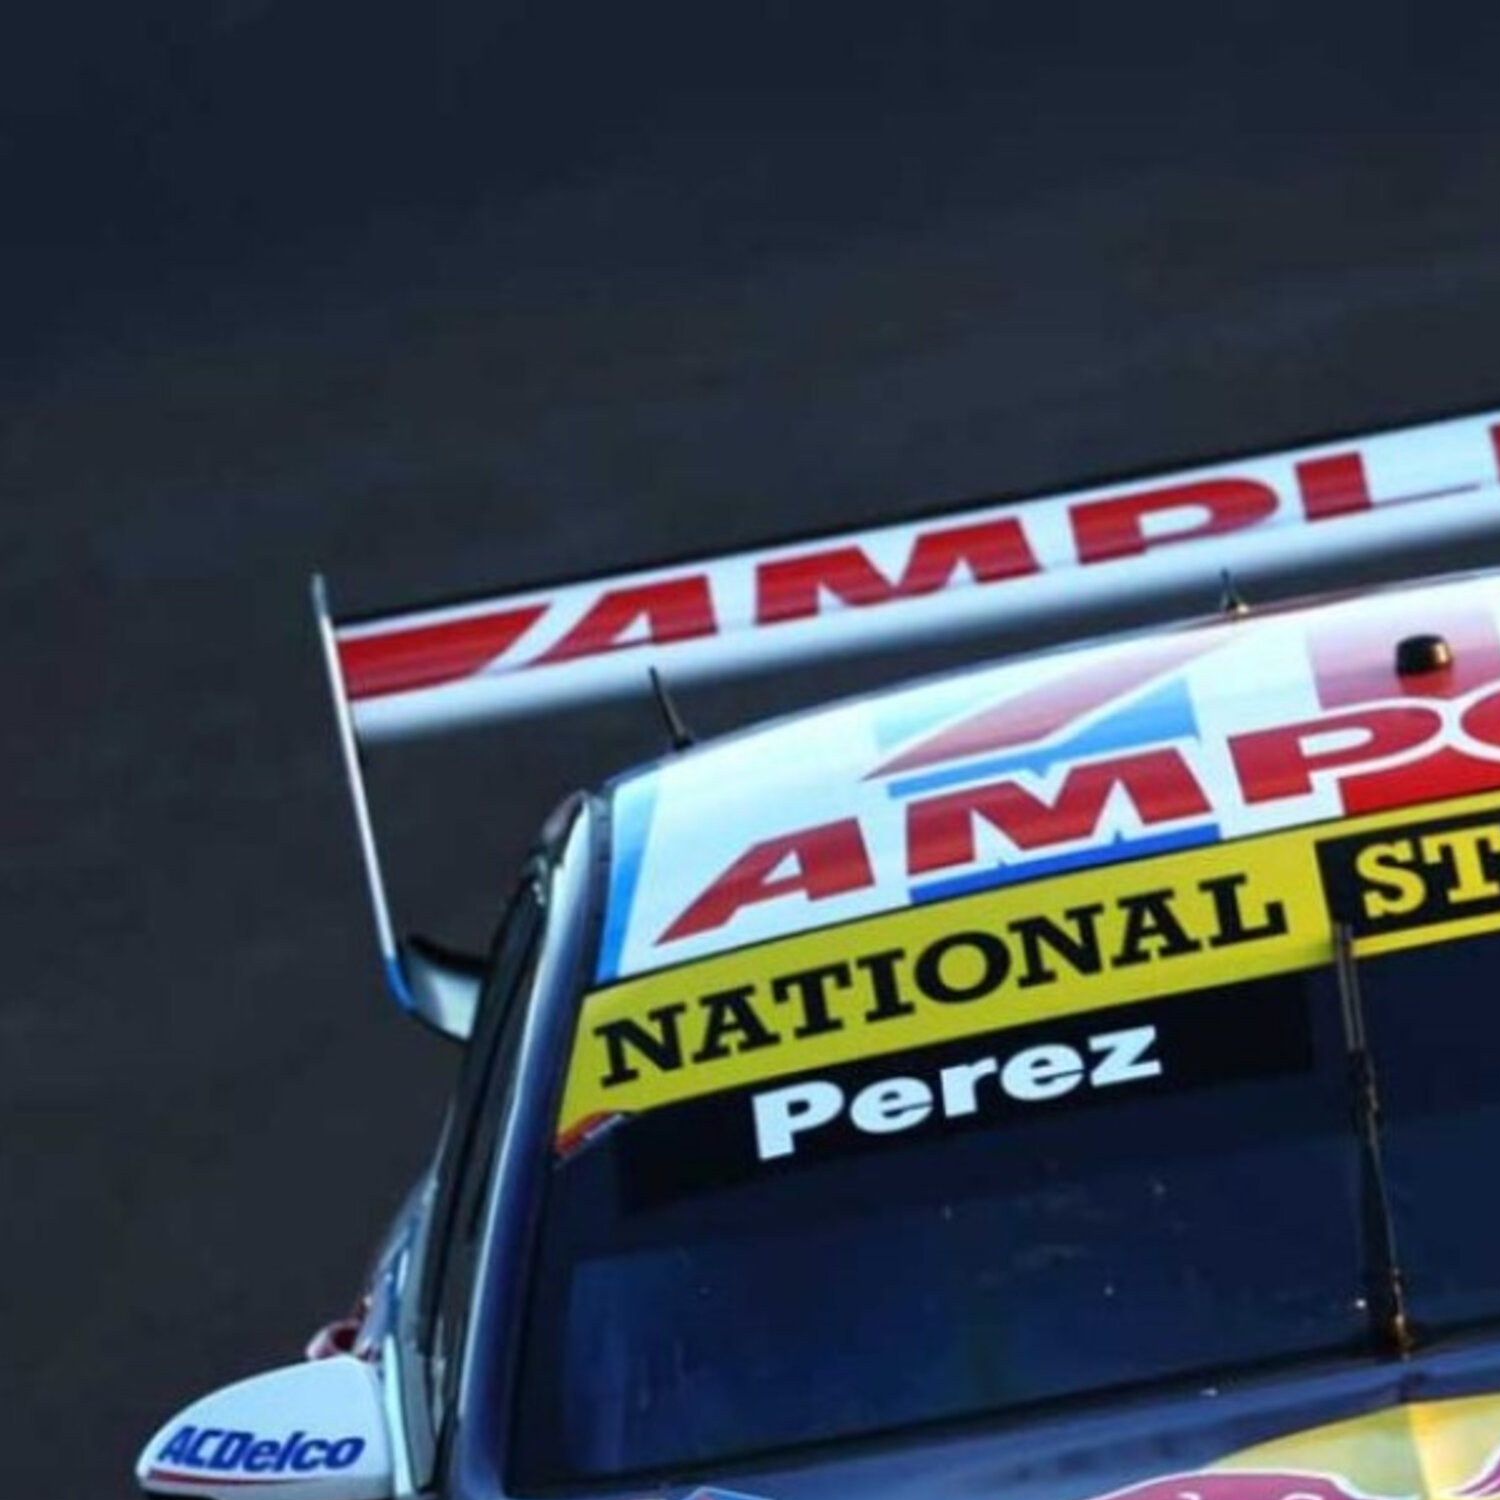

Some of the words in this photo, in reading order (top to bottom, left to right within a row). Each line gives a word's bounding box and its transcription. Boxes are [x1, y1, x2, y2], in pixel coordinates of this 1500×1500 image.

[595, 873, 1287, 1086] NATIONAL
[751, 1026, 1163, 1159] Perez
[156, 1425, 367, 1473] ACDelco
